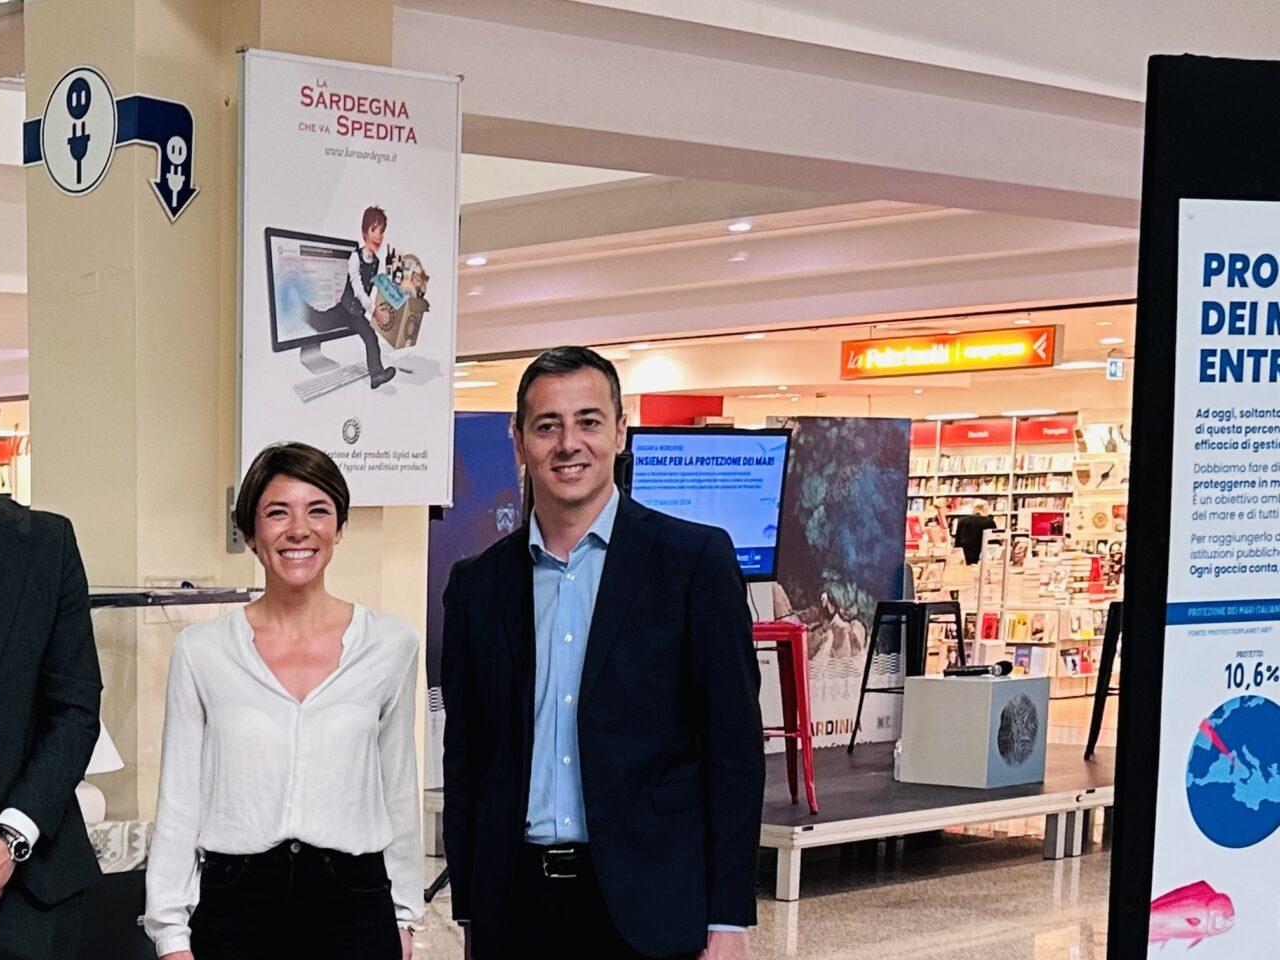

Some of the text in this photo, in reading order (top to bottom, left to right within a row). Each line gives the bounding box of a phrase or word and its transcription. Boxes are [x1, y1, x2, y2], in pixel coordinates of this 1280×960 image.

[316, 78, 328, 88] LA
[300, 85, 410, 119] SARDEGNA
[298, 114, 418, 144] CHE VA SPEDITA
[1203, 253, 1280, 289] PRO
[1201, 300, 1259, 335] DEI
[846, 350, 863, 369] la
[866, 342, 950, 369] Feltrinelli
[1195, 408, 1210, 418] Ad
[1211, 408, 1237, 421] oggi,
[1195, 424, 1204, 434] di
[1206, 424, 1242, 437] questa
[1194, 439, 1239, 450] efficacia
[1241, 438, 1251, 449] di
[351, 449, 362, 458] dei
[635, 456, 668, 466] INSIEME
[669, 456, 684, 466] PER
[684, 456, 693, 466] LA
[695, 456, 742, 466] PROTEZIONE
[742, 457, 754, 466] DEI
[1194, 463, 1246, 473] Dobbiamo
[1248, 462, 1269, 473] fare
[1193, 479, 1257, 493] proteggerne
[1258, 477, 1268, 488] in
[1200, 496, 1213, 505] un
[1214, 493, 1259, 505] obiettivo
[1192, 508, 1279, 520] del mare e di tutti
[1191, 531, 1273, 547] Per raggiungerlo
[1190, 548, 1235, 559] istituzioni
[1190, 563, 1279, 578] Ogni goccia conta.
[1225, 661, 1279, 691] 10,6%
